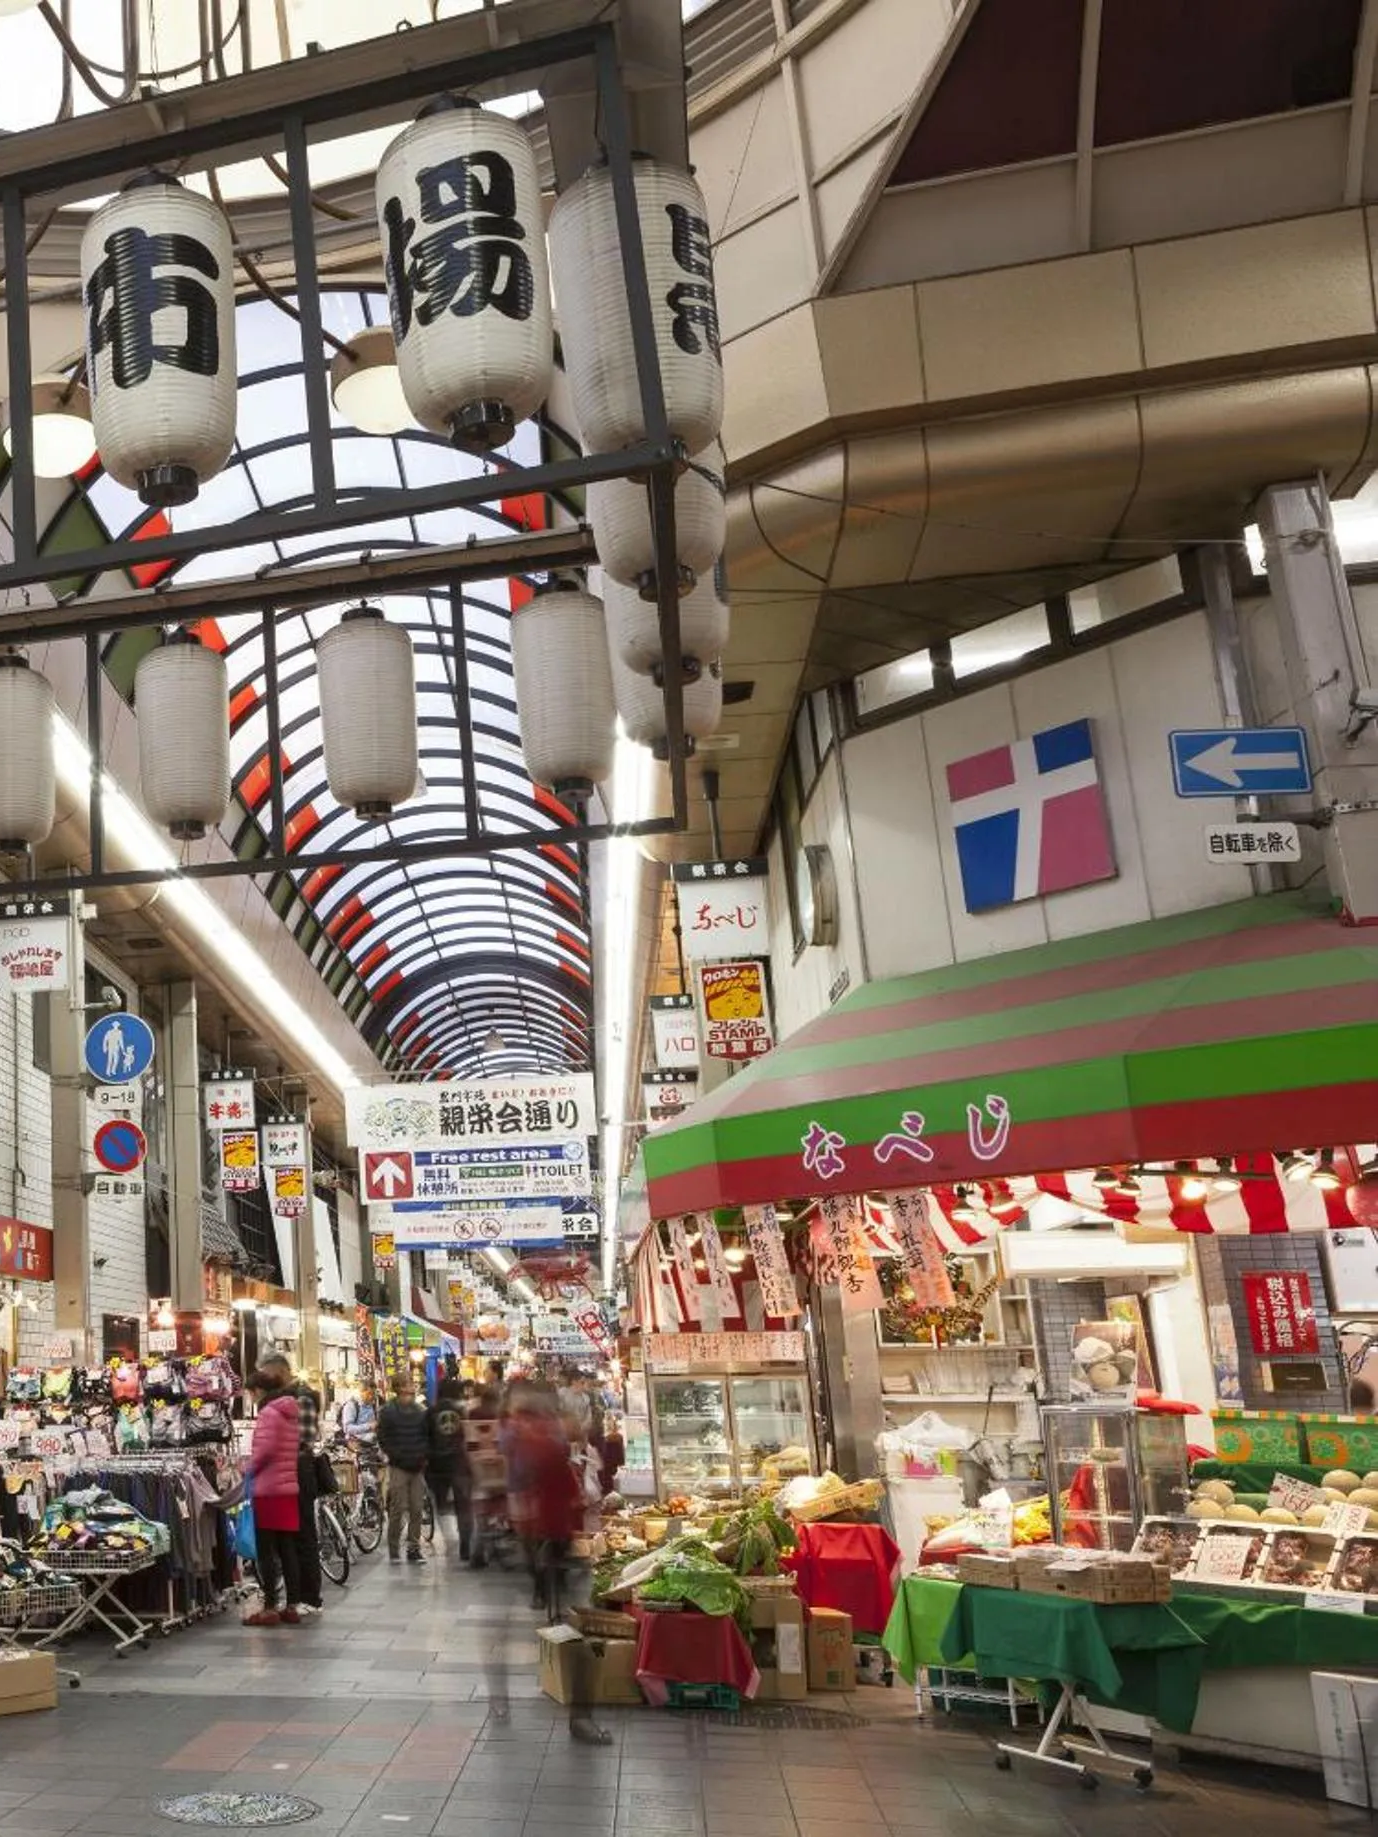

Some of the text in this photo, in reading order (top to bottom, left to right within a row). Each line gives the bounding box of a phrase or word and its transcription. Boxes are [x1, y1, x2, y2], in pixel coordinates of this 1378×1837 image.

[383, 149, 534, 347] 場
[1209, 832, 1296, 854] 自転車を除く
[709, 1027, 766, 1041] STAMP
[439, 1100, 580, 1137] 親栄会通り
[801, 1094, 1011, 1179] なべじ
[431, 1149, 550, 1164] Free rest area
[539, 1164, 583, 1177] TOILET
